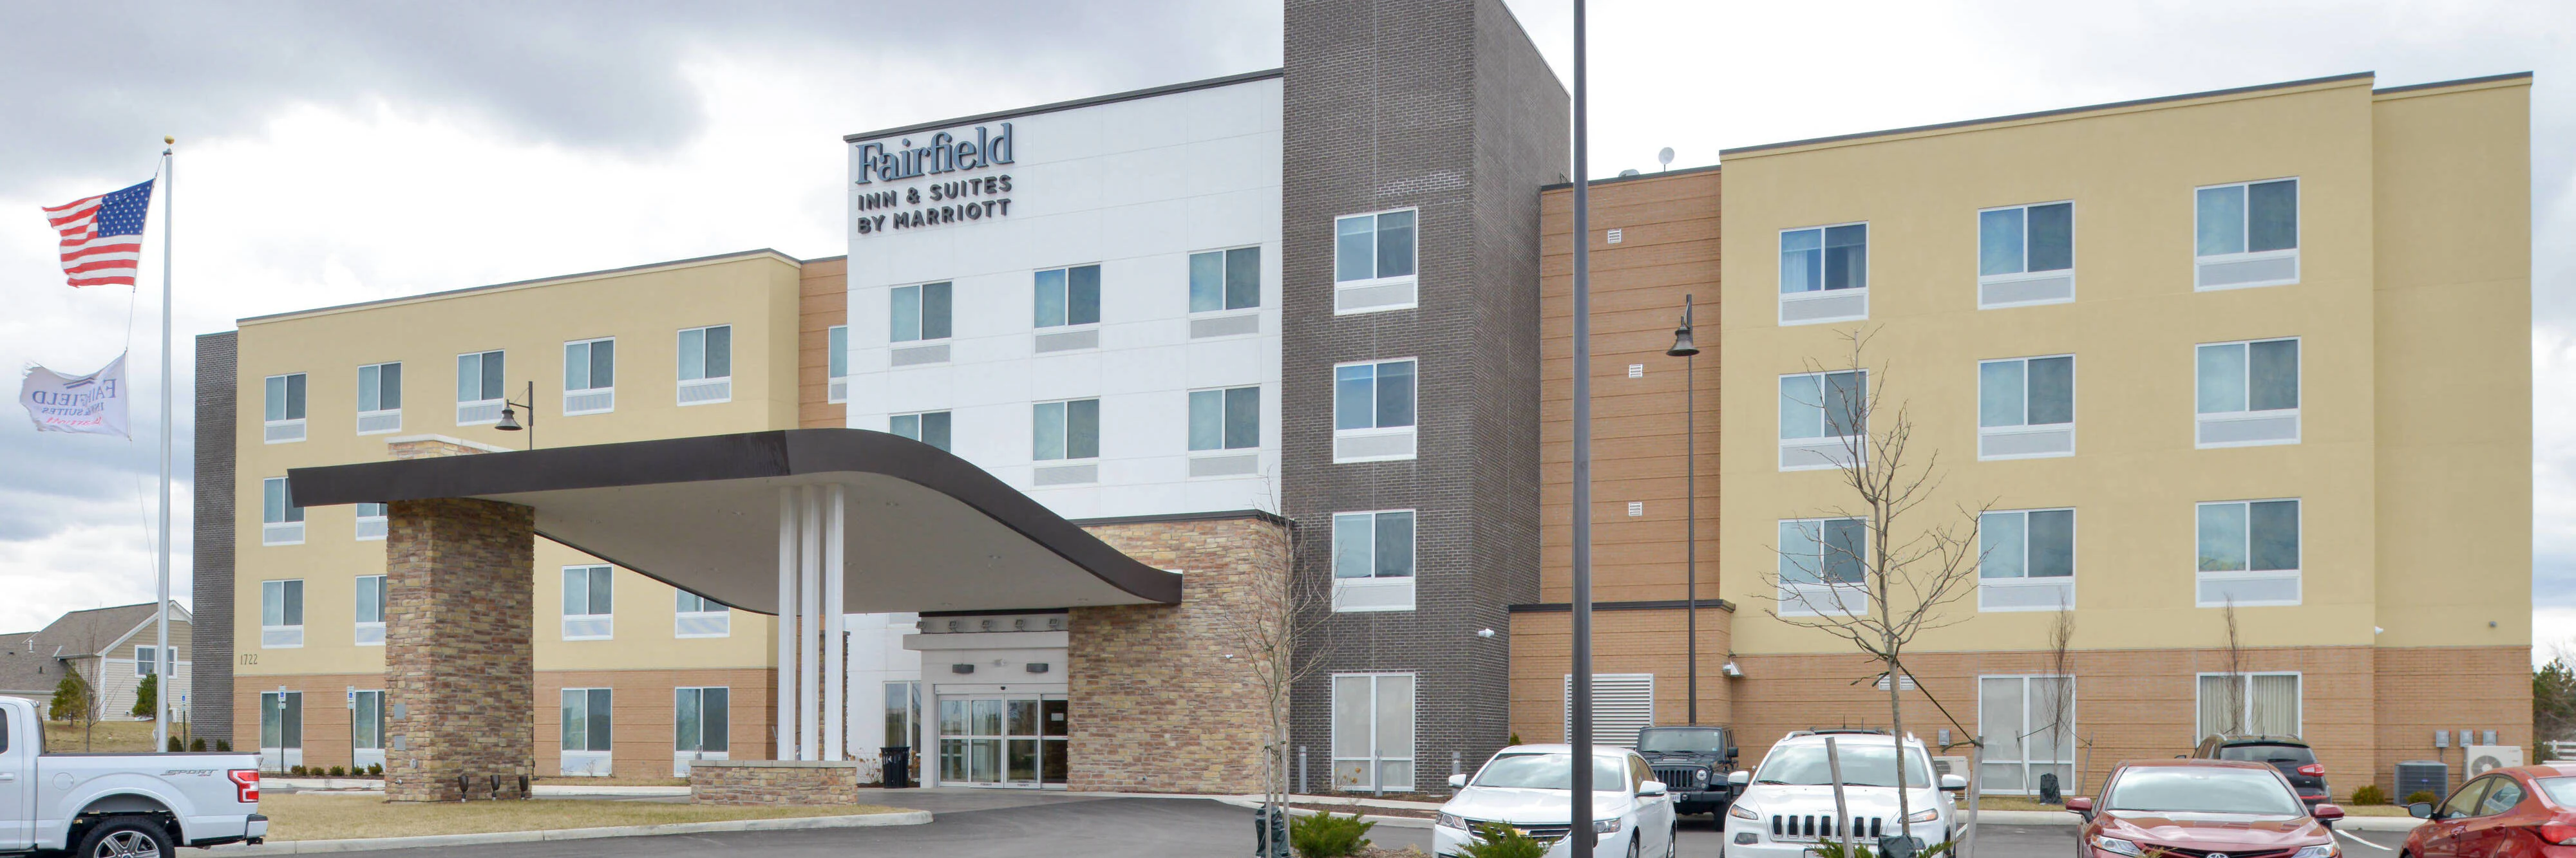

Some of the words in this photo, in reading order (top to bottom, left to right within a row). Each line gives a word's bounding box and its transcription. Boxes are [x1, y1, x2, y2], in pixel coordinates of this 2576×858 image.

[855, 122, 1015, 185] Fairfield
[858, 190, 897, 211] INN
[906, 187, 920, 204] &
[929, 174, 1012, 201] SUITES
[858, 214, 886, 234] BY
[893, 198, 1011, 230] MARRIOTT
[240, 654, 258, 665] 1722
